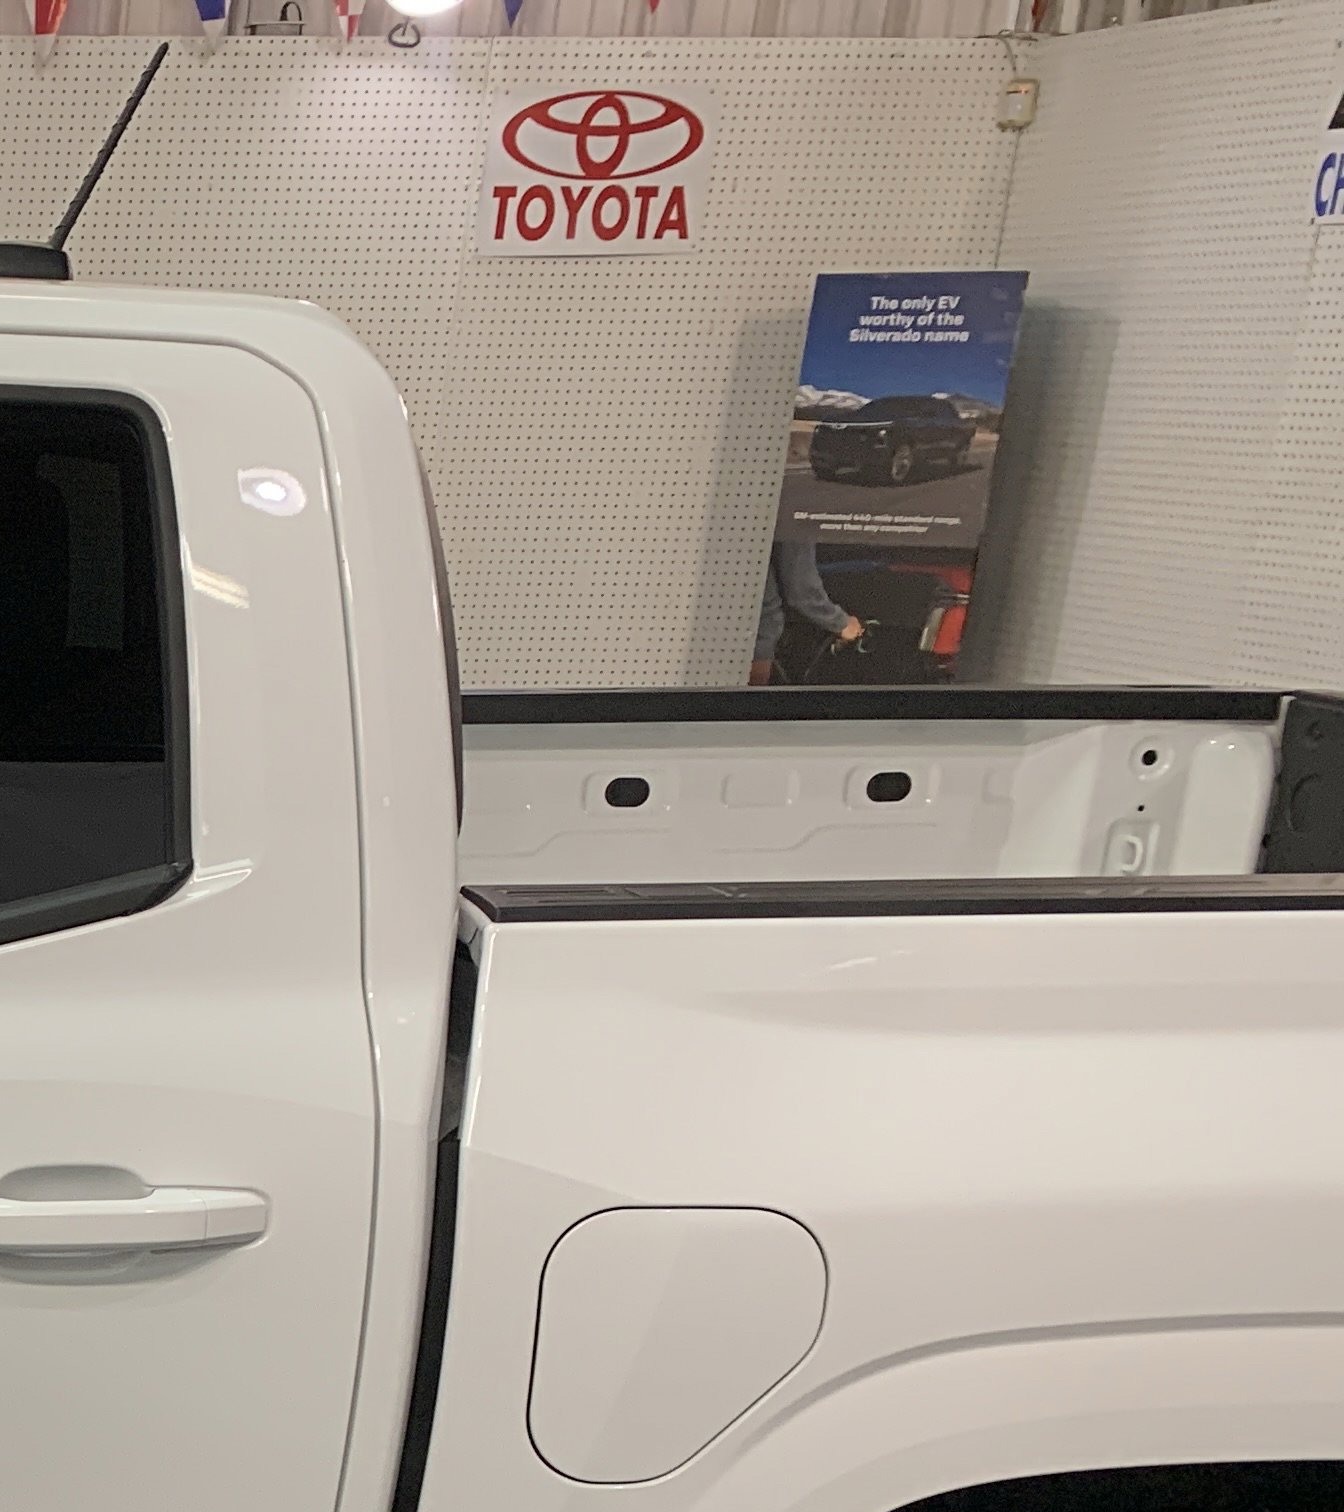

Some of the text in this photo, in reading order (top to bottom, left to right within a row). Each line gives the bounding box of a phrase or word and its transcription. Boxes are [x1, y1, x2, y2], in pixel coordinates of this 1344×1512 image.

[492, 184, 689, 241] TOYOTA
[870, 296, 960, 311] The only EV
[859, 312, 965, 328] worthy of the
[849, 328, 970, 342] Silverado name
